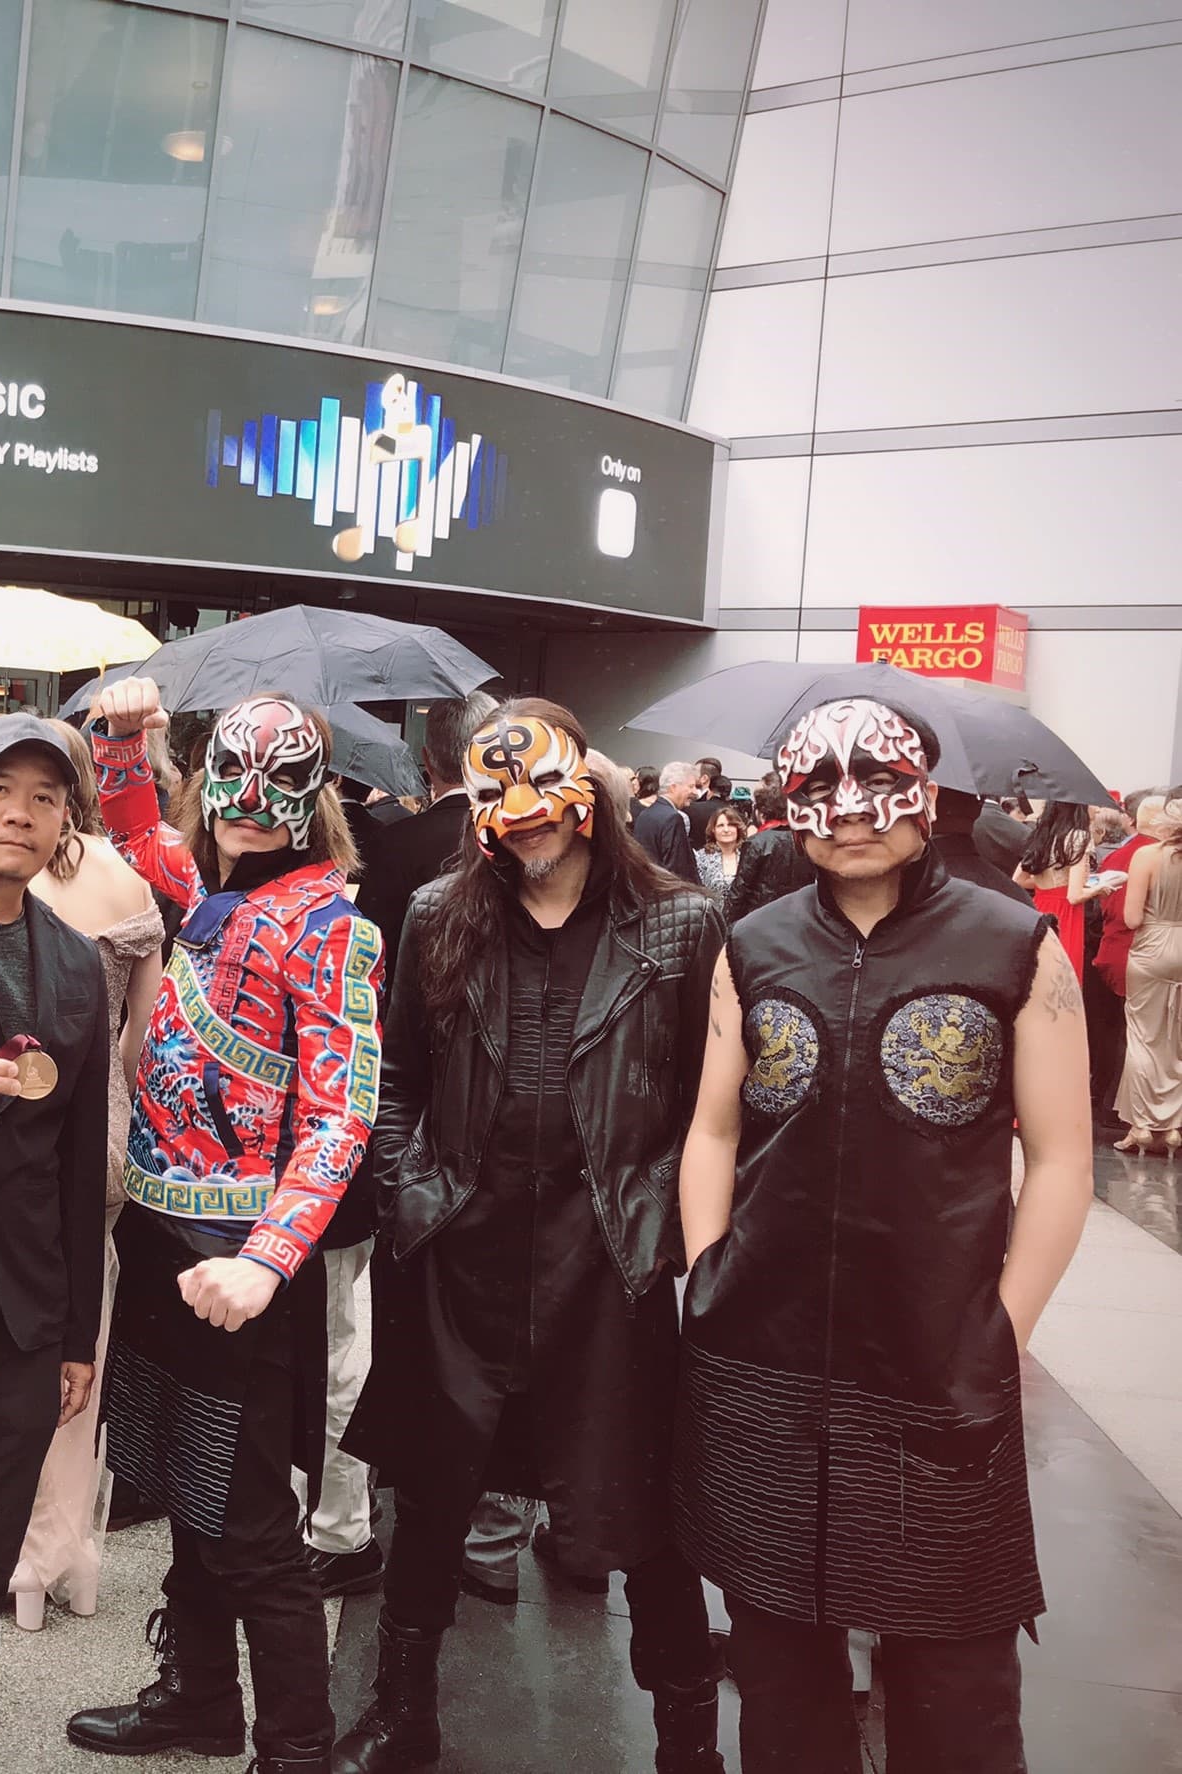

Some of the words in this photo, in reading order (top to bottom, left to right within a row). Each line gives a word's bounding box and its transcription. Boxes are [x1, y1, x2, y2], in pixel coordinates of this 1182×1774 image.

[13, 443, 99, 474] Playlists
[601, 455, 627, 483] Only
[627, 466, 641, 483] on
[869, 622, 985, 644] WELLS
[870, 647, 983, 669] FARGO
